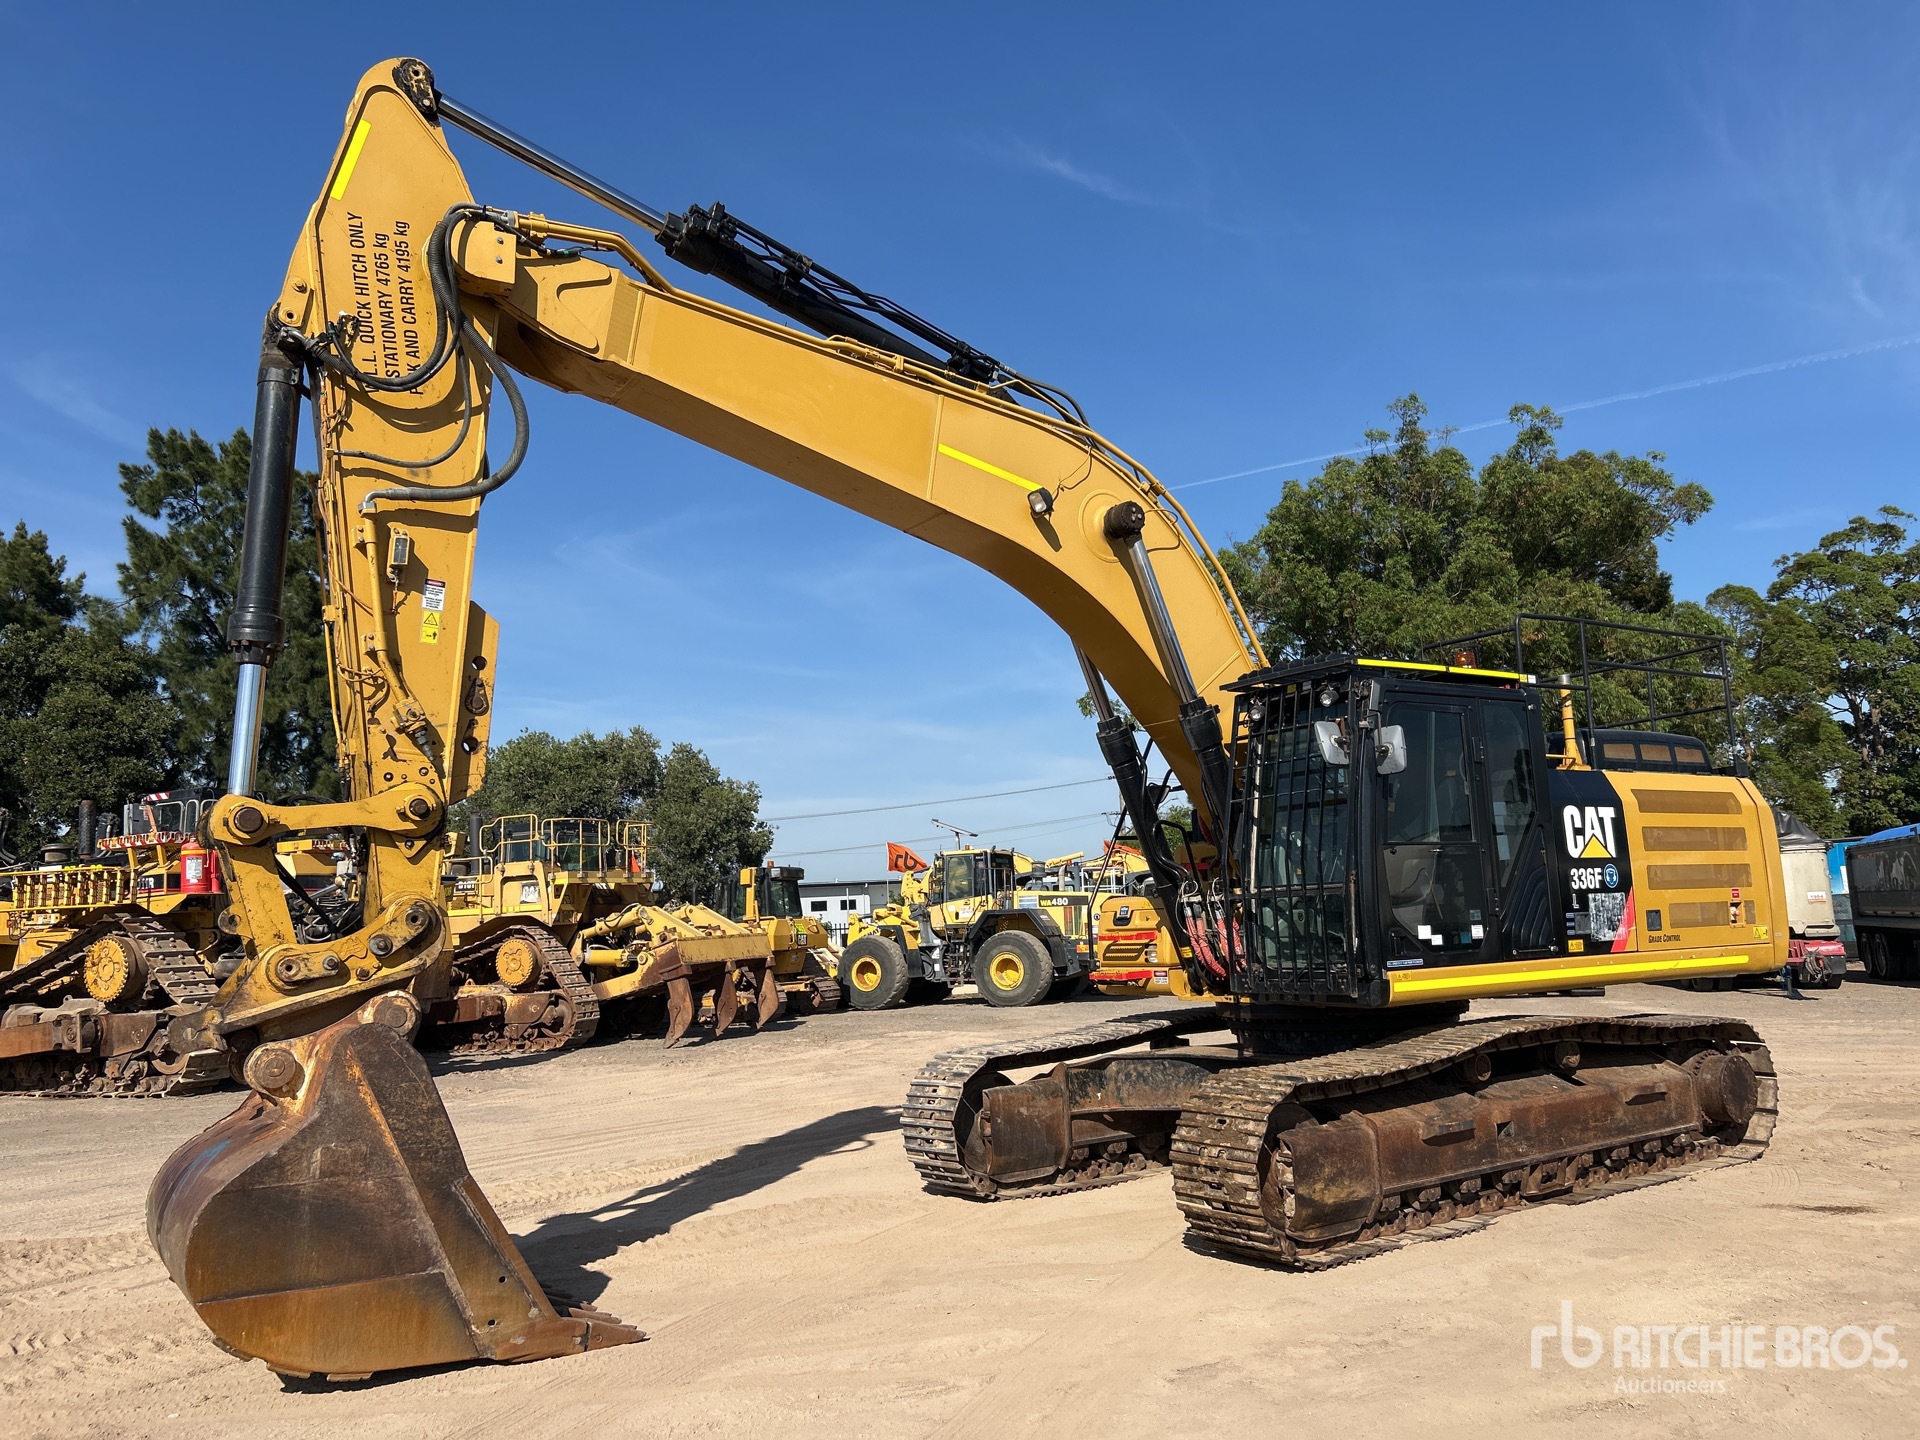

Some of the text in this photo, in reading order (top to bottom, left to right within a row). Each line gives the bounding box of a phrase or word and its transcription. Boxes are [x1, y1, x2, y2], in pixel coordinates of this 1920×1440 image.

[347, 211, 365, 249] ONLY
[351, 253, 370, 297] HITCH
[356, 301, 375, 343] QUICK
[372, 233, 401, 379] STATIONARY 4765 kg
[393, 221, 424, 395] PK AND CARRY 4195 kg
[1563, 804, 1617, 859] CAT
[1570, 867, 1602, 889] 336F
[1040, 897, 1068, 906] WA480
[1571, 893, 1580, 909] L
